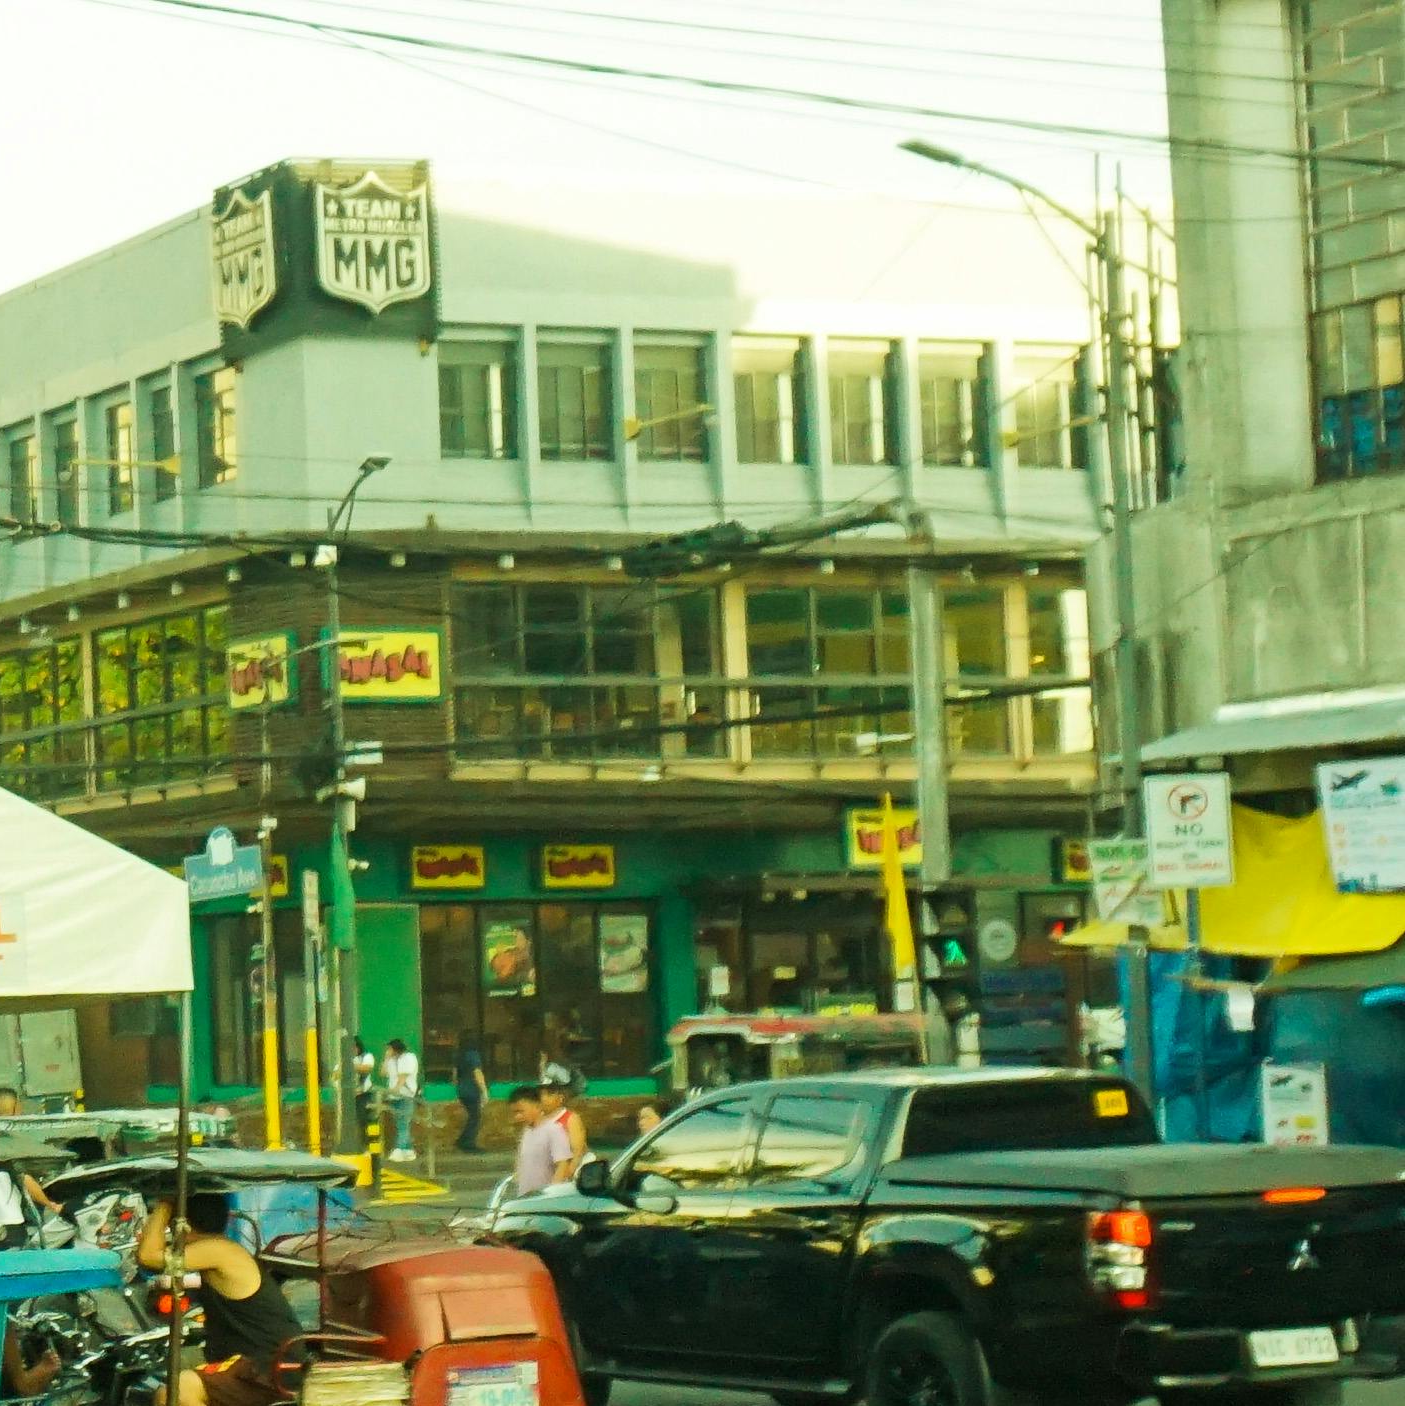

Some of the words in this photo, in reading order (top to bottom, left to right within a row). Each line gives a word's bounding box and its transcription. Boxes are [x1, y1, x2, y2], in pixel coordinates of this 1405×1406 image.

[343, 200, 401, 218] TEAM
[335, 239, 415, 289] MMG
[1174, 824, 1203, 836] NO
